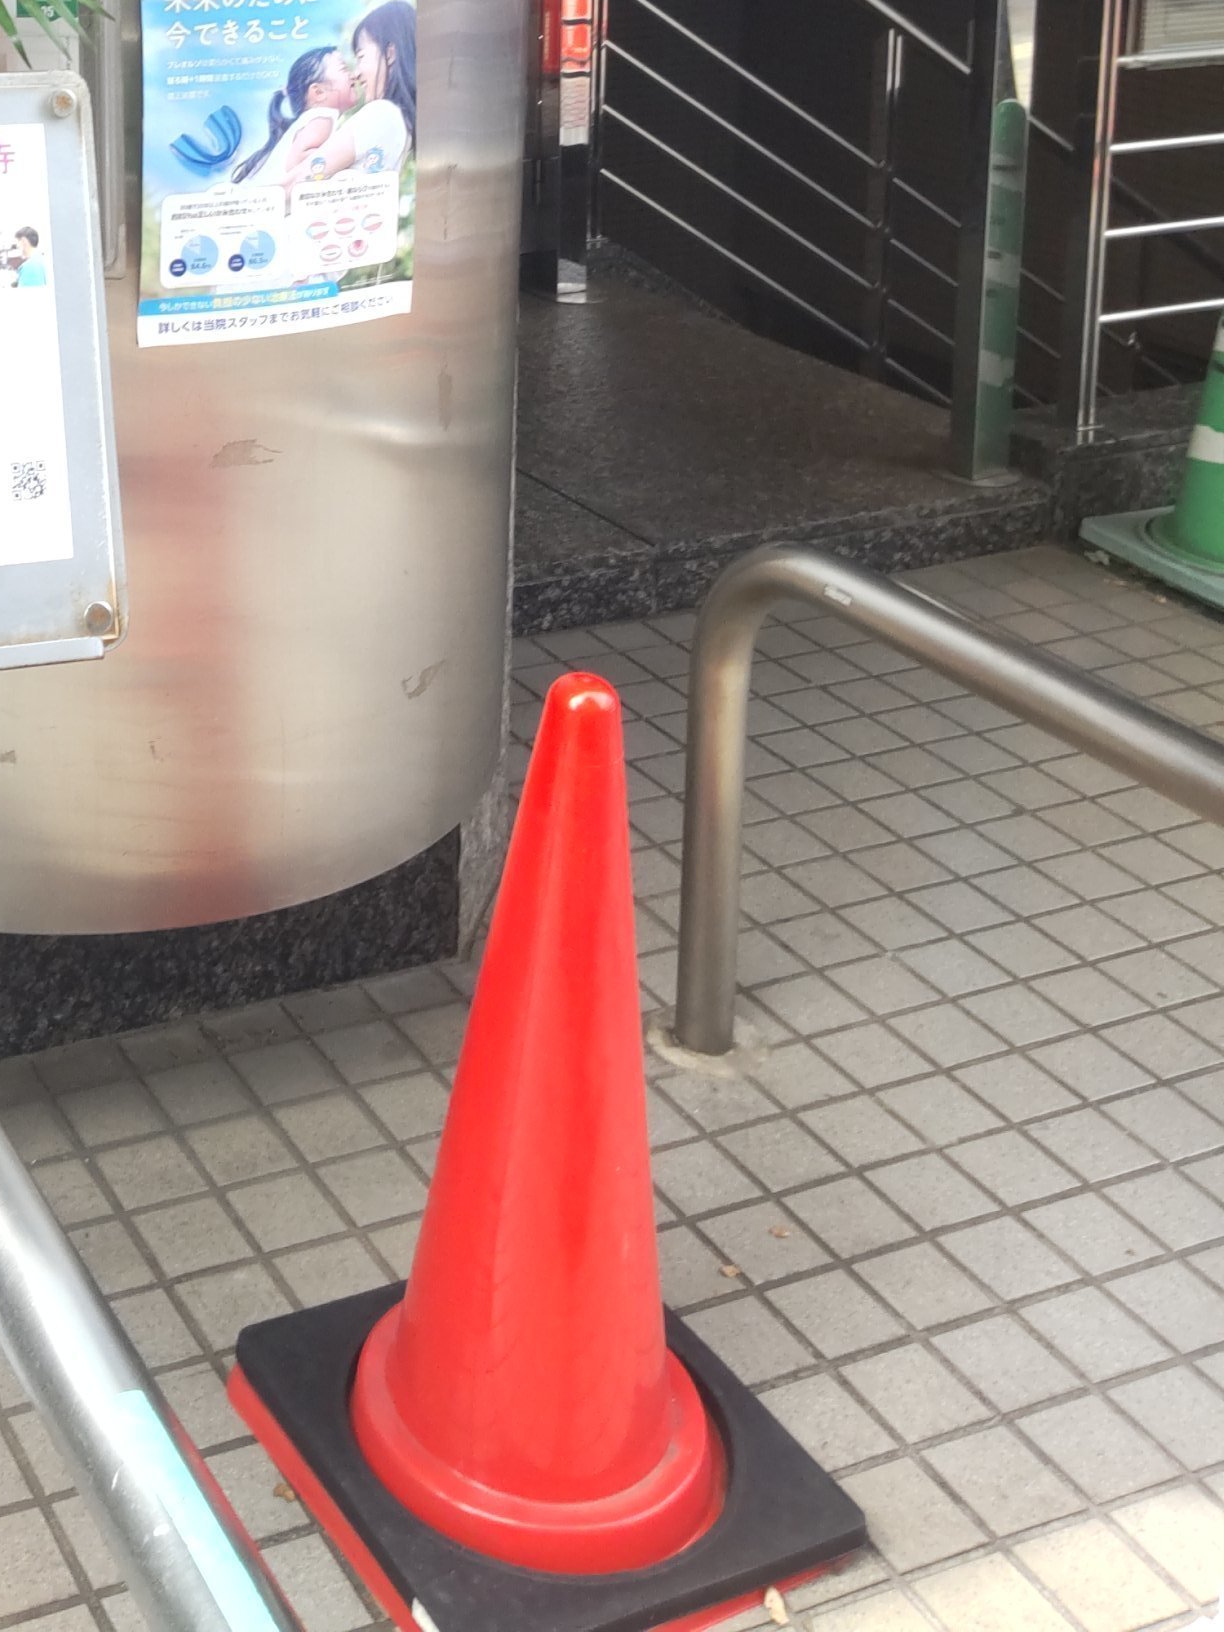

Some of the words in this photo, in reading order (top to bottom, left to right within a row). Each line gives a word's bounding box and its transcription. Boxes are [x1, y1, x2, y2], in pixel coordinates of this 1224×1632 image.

[165, 15, 310, 49] 今できること
